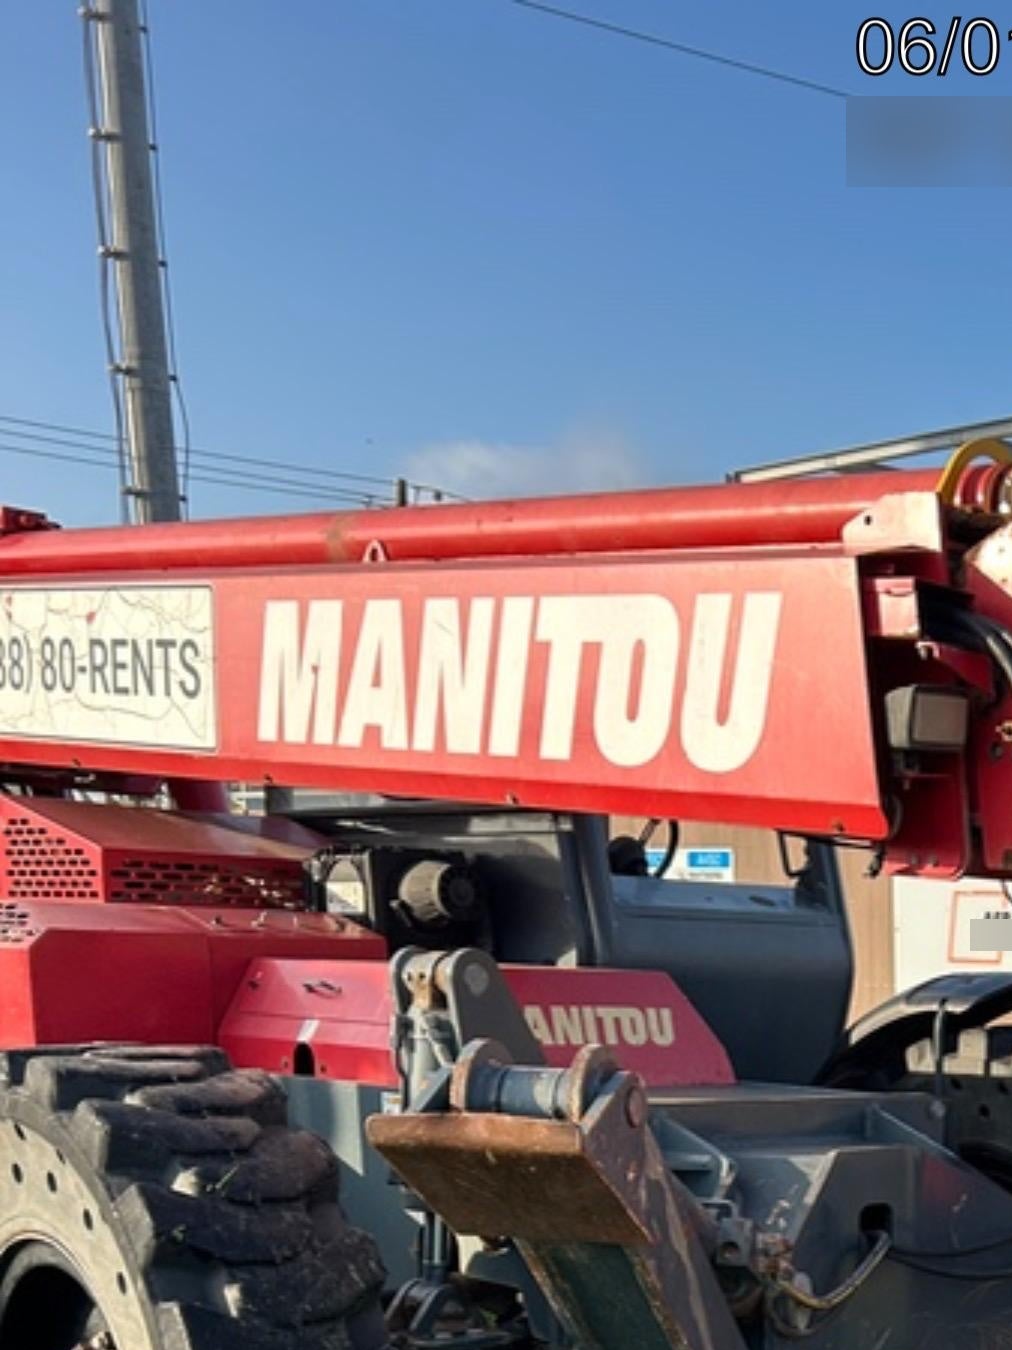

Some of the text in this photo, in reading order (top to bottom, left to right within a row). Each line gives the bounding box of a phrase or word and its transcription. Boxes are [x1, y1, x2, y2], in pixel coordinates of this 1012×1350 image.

[40, 636, 202, 699] 80-RENTS
[257, 591, 783, 773] MANITOU
[523, 1004, 675, 1046] ANITOU
